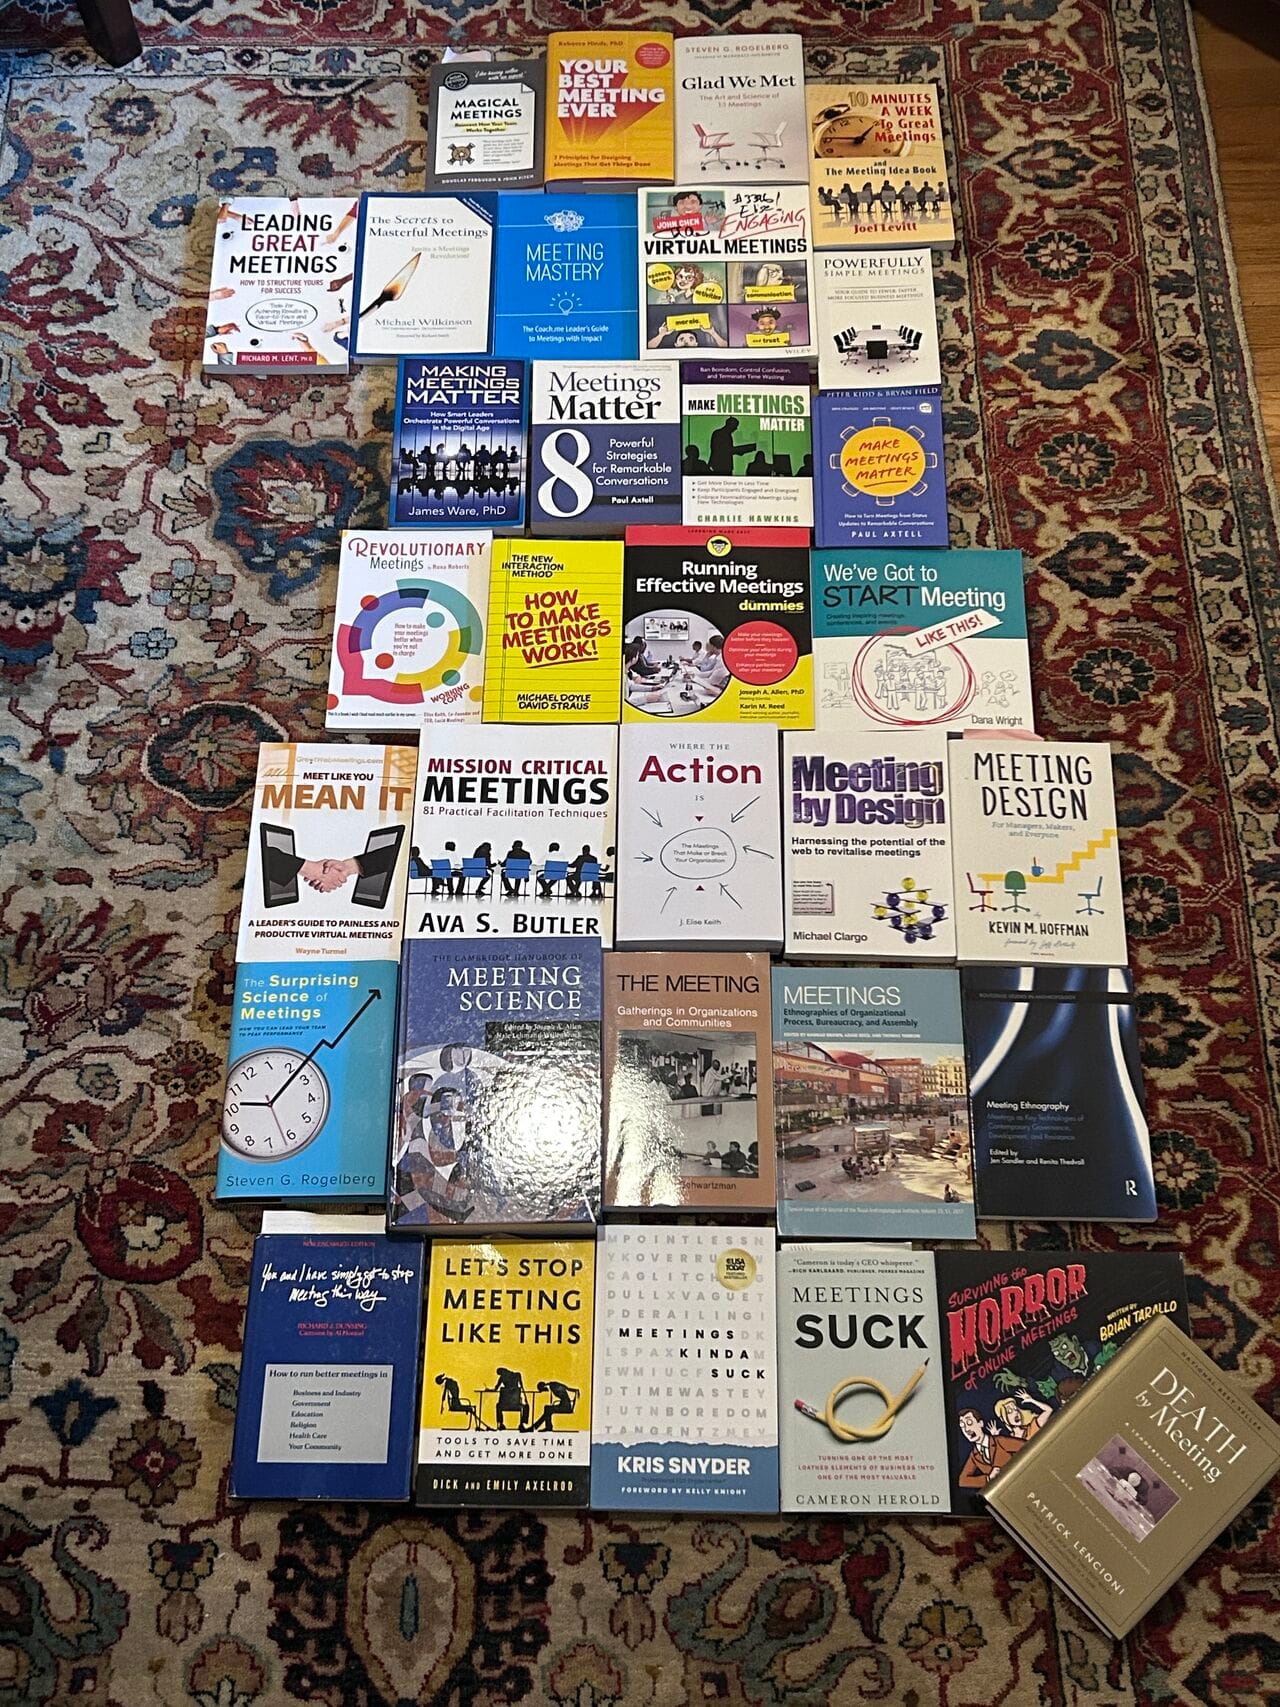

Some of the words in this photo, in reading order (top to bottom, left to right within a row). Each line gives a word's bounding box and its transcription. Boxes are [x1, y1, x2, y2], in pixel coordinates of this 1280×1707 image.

[560, 59, 627, 73] YOUR
[558, 75, 613, 88] BEST
[682, 76, 727, 90] Glad
[730, 76, 757, 88] We
[761, 75, 796, 88] Met
[558, 88, 665, 103] MEETING
[455, 98, 519, 109] MAGICAL
[558, 104, 616, 118] EVER
[451, 109, 522, 121] MEETINGS
[826, 168, 842, 176] The
[846, 167, 886, 176] Meeting
[889, 167, 909, 175] Idea
[913, 166, 936, 174] Book
[242, 214, 332, 231] LEADING
[394, 216, 438, 224] Secrets
[369, 227, 429, 237] Masterful
[432, 227, 488, 239] Meetings
[252, 235, 319, 252] GREAT
[644, 240, 721, 255] VIRTUAL
[724, 238, 807, 254] MEETINGS
[527, 243, 604, 260] MEETING
[229, 256, 337, 274] MEETINGS
[824, 256, 923, 268] POWERFULLY
[527, 263, 604, 280] MASTERY
[422, 365, 507, 376] MAKING
[407, 378, 520, 389] MEETINGS
[548, 372, 661, 400] Meetings
[407, 390, 520, 405] MATTER
[688, 400, 715, 411] MAKE
[716, 394, 805, 415] MEETINGS
[547, 395, 661, 420] Matter
[760, 418, 805, 432] MATTER
[610, 438, 654, 449] Powerful
[859, 439, 900, 451] MAKE
[606, 451, 658, 461] Strategies
[844, 451, 919, 467] MEETINGS
[538, 428, 594, 518] 8
[592, 463, 608, 474] for
[610, 464, 672, 474] Remarkable
[856, 466, 916, 480] MATTER
[596, 476, 668, 486] Conversations
[370, 556, 424, 571] Meetings
[502, 562, 564, 571] INTERACTION
[531, 555, 553, 563] NEW
[512, 570, 553, 578] METHOD
[682, 561, 758, 580] Running
[824, 564, 878, 582] We've
[884, 564, 915, 582] Got
[920, 565, 938, 582] to
[636, 579, 715, 592] Effective
[720, 579, 804, 597] Meetings
[525, 590, 578, 610] HOW
[739, 600, 804, 611] dummies
[823, 585, 920, 608] START
[921, 587, 1006, 611] Meeting
[507, 613, 536, 629] TO
[538, 603, 600, 623] MAKE
[502, 620, 611, 649] MEETINGS
[916, 629, 947, 648] LIKE
[946, 614, 983, 638] THIS!
[522, 641, 598, 664] WORK!
[427, 758, 512, 774] MISSION
[522, 760, 608, 775] CRITICAL
[639, 755, 762, 784] Action
[974, 753, 1092, 786] MEETING
[303, 772, 330, 780] MEET
[331, 772, 351, 780] LIKE
[353, 773, 374, 781] YOU
[792, 756, 944, 796] Meeting
[261, 784, 365, 810] MEAN
[378, 786, 411, 812] IT
[423, 776, 609, 805] MEETINGS
[792, 793, 831, 827] by
[836, 794, 946, 828] Design
[982, 786, 1088, 820] DESIGN
[423, 806, 434, 814] 81
[439, 807, 483, 816] Practical
[487, 808, 544, 817] Facilitation
[549, 809, 608, 819] Techniques
[792, 837, 848, 846] Harnessing
[870, 838, 913, 847] potential
[917, 838, 927, 846] of
[929, 838, 946, 846] the
[827, 848, 872, 856] revitalise
[875, 849, 921, 857] meetings
[254, 930, 310, 938] PRODUCTIVE
[349, 931, 393, 939] MEETINGS
[244, 978, 265, 987] The
[269, 975, 360, 989] Surprising
[446, 966, 582, 987] MEETING
[617, 975, 659, 991] THE
[666, 976, 760, 993] MEETING
[242, 991, 309, 1003] Science
[316, 992, 328, 1002] of
[459, 990, 582, 1011] SCIENCE
[784, 986, 901, 1005] MEETINGS
[240, 1007, 321, 1021] Meetings
[617, 1006, 673, 1017] Gatherings
[676, 1006, 685, 1016] in
[689, 1007, 758, 1018] Organizations
[643, 1018, 662, 1027] and
[666, 1018, 732, 1028] Communities
[986, 1101, 1018, 1111] Meeting
[1020, 1102, 1070, 1112] Ethnography
[446, 1258, 508, 1276] LET'S
[518, 1259, 583, 1276] STOP
[793, 1287, 923, 1304] MEETINGS
[949, 1272, 1008, 1308] SURVIVING
[1011, 1268, 1027, 1281] the
[443, 1289, 581, 1310] MEETING
[947, 1264, 1088, 1381] HORROR
[442, 1323, 501, 1343] LIKE
[514, 1324, 581, 1344] THIS
[619, 1328, 734, 1340] MEETINGS
[794, 1314, 928, 1350] SUCK
[680, 1348, 749, 1360] KINDA
[964, 1371, 977, 1391] of
[978, 1347, 1016, 1378] ONLINE
[1021, 1307, 1078, 1348] MEETINGS
[269, 1369, 288, 1378] How
[290, 1370, 298, 1378] to
[315, 1370, 340, 1378] better
[341, 1370, 378, 1379] meetings
[380, 1370, 388, 1378] in
[711, 1368, 766, 1379] SUCK
[1149, 1367, 1248, 1465] DEATH
[437, 1437, 478, 1445] TOOLS
[484, 1438, 500, 1446] TO
[507, 1438, 536, 1446] SAVE
[543, 1438, 573, 1446] TIME
[1135, 1390, 1153, 1408] by
[1150, 1406, 1223, 1484] Meeting
[436, 1450, 461, 1458] AND
[498, 1451, 532, 1459] MORE
[539, 1451, 573, 1459] DONE
